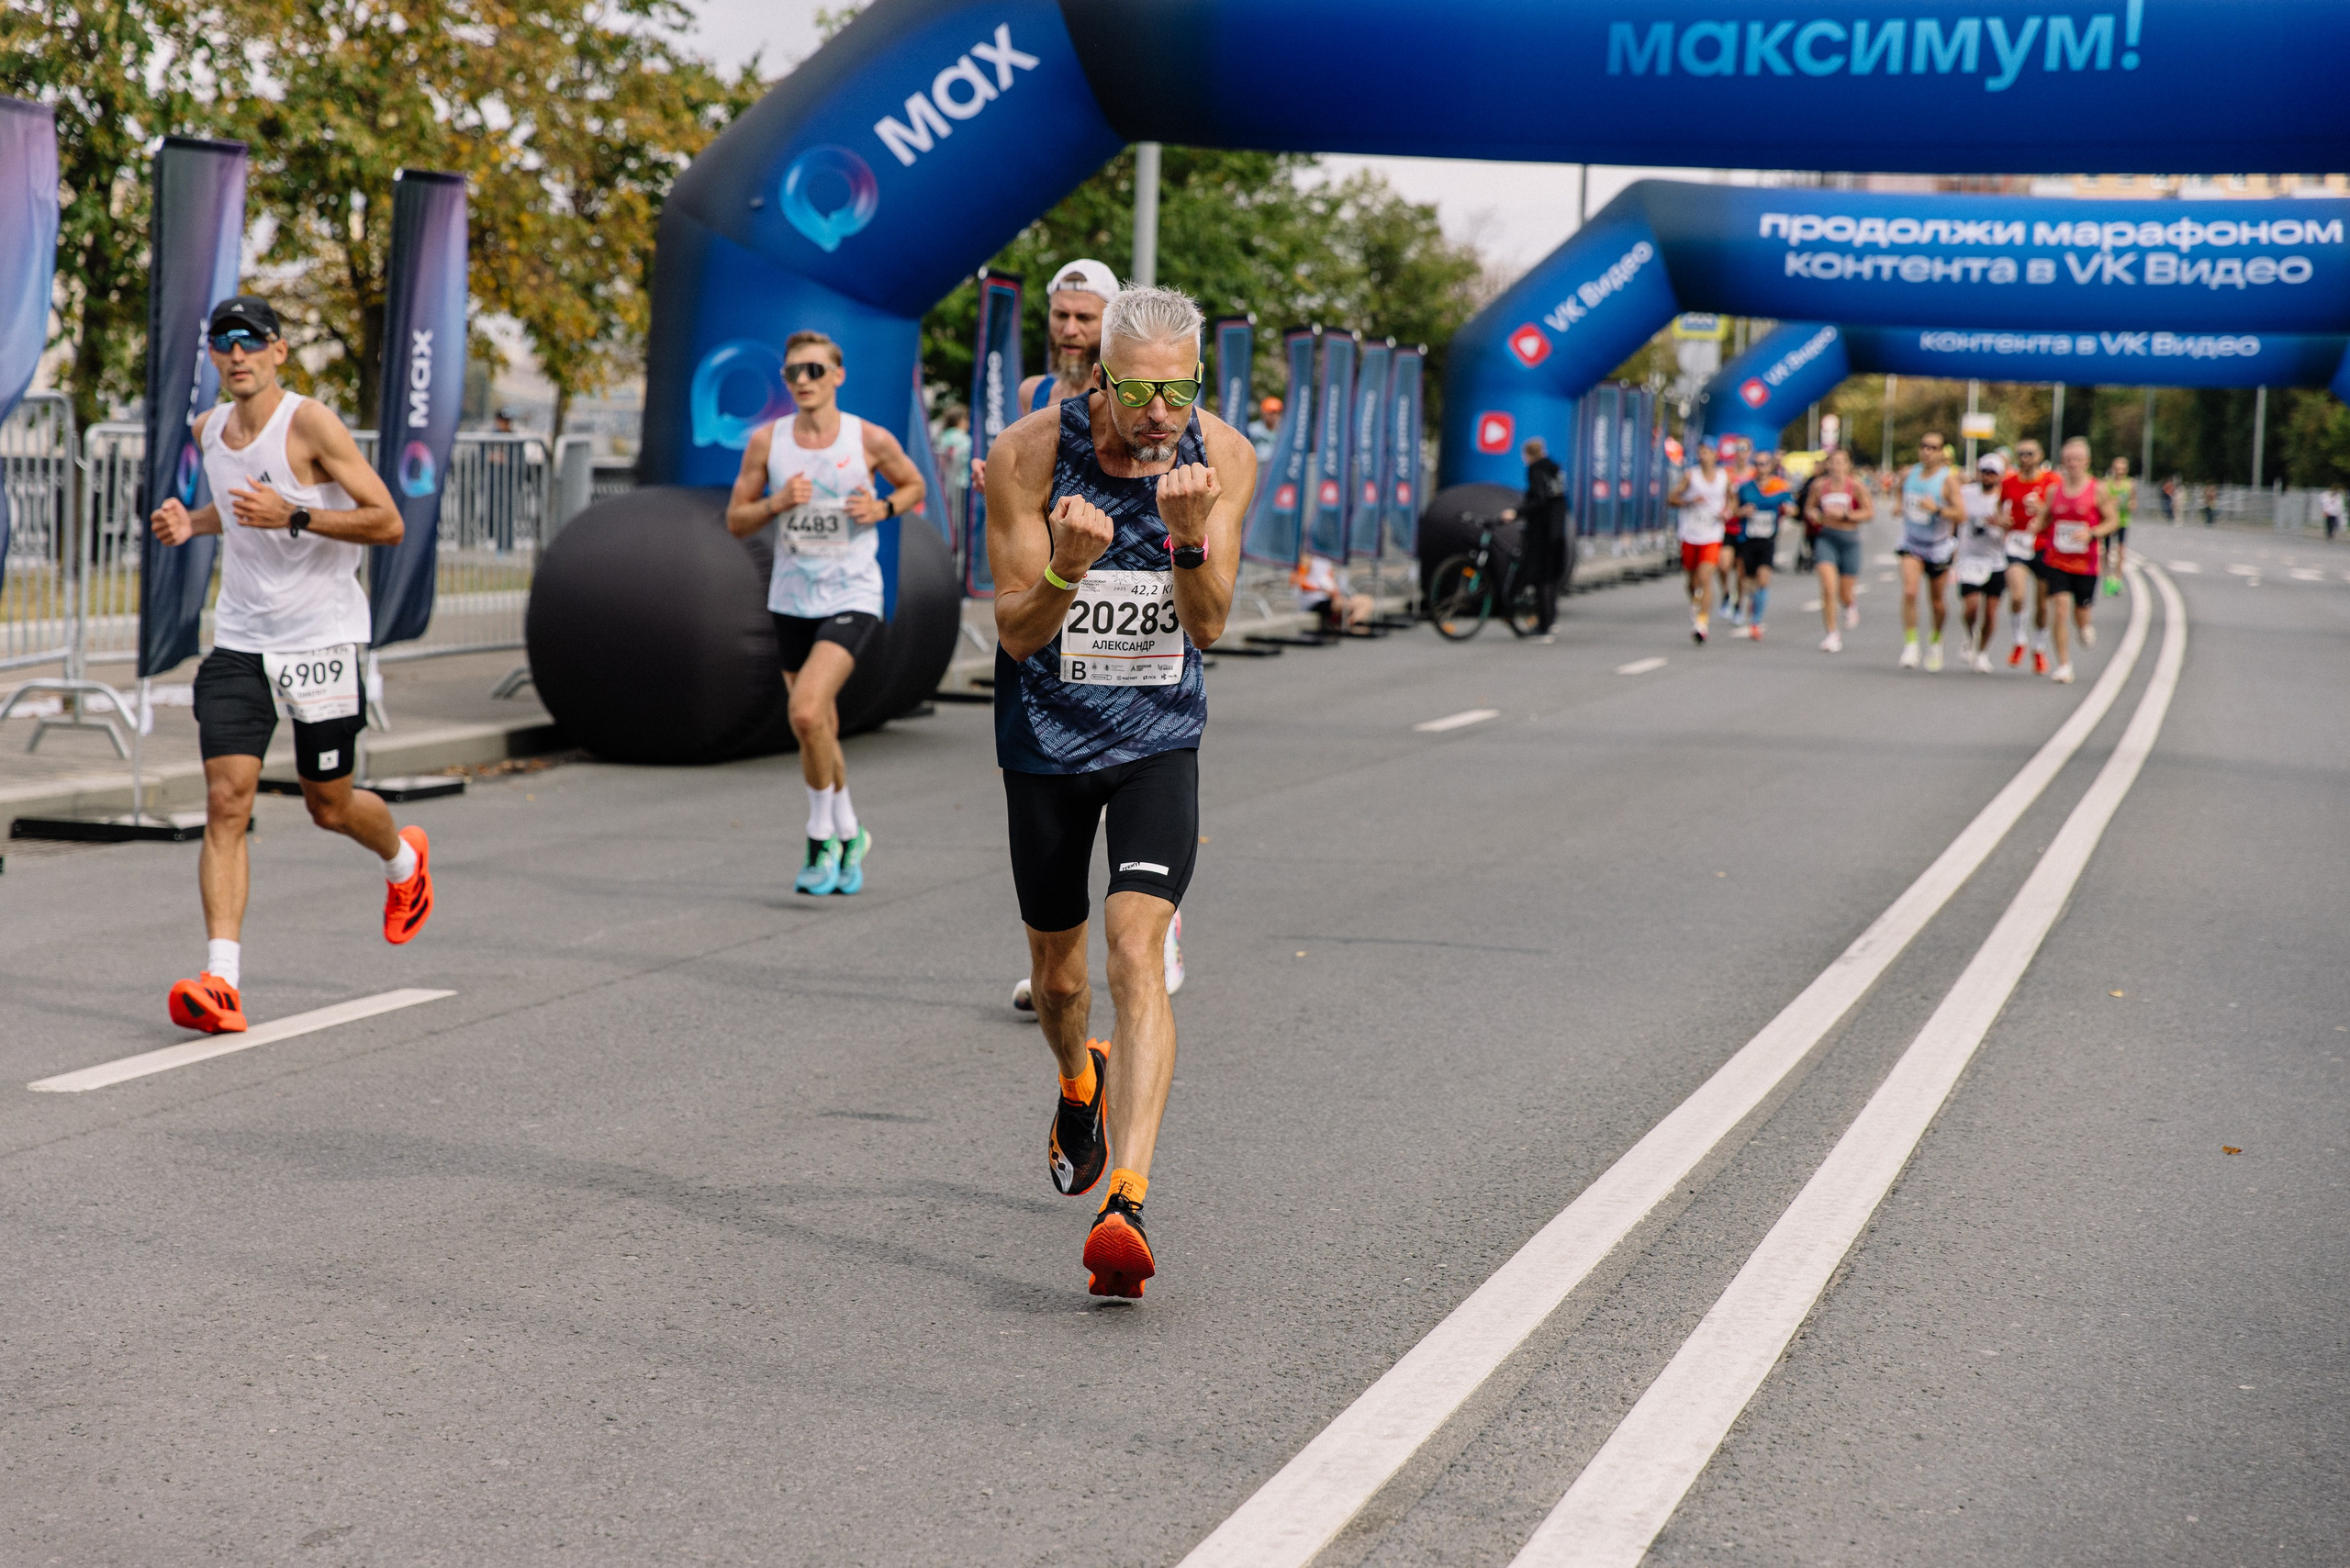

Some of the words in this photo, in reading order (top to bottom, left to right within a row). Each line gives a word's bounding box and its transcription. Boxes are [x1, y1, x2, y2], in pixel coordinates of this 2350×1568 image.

[1606, 0, 2144, 92] максимум!
[1759, 212, 2026, 248] продолжи
[2032, 217, 2344, 253] марафоном
[1785, 251, 2018, 284] контента
[2026, 258, 2056, 285] в
[2064, 252, 2138, 285] VK
[2144, 252, 2313, 290] Видео
[1544, 294, 1588, 332] VK
[2099, 331, 2149, 356] VK
[787, 515, 838, 532] 4483
[1131, 585, 1158, 596] 42,2
[1068, 599, 1180, 635] 20283
[1092, 640, 1156, 652] АЛЕКСАНДР
[279, 660, 343, 689] 6909
